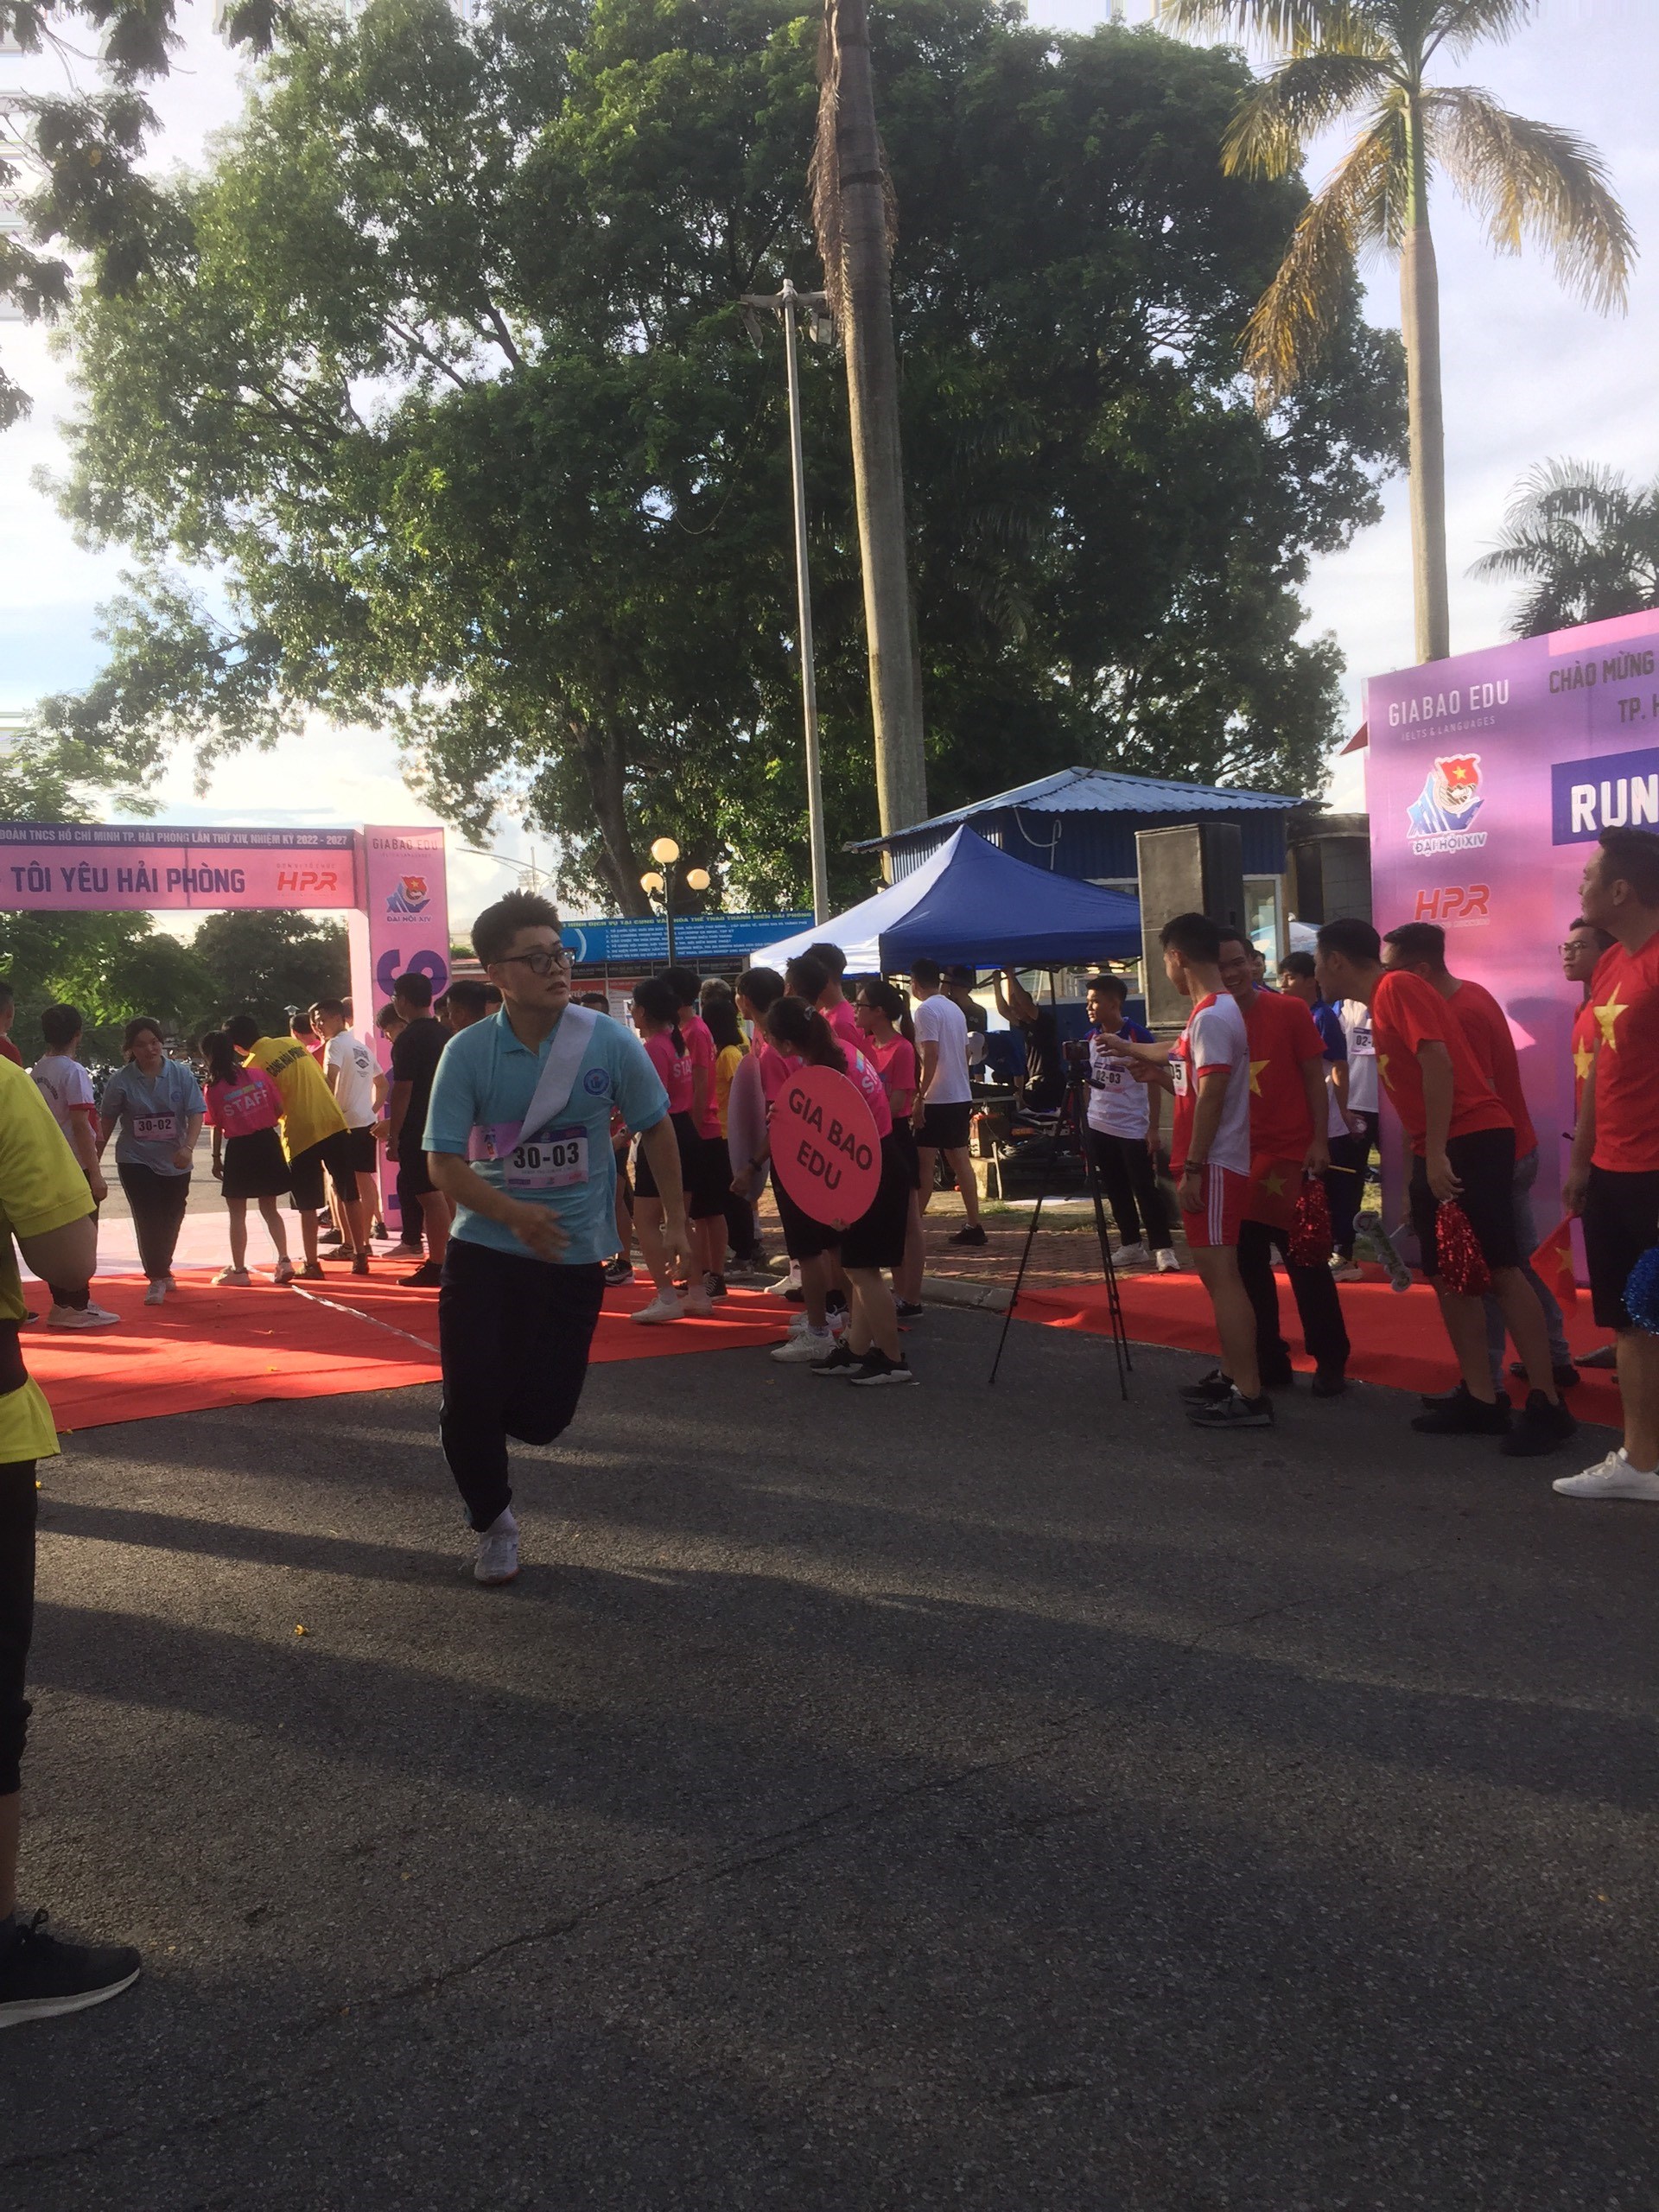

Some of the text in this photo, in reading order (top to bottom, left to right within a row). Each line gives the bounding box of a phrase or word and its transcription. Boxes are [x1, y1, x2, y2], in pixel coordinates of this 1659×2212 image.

[1549, 650, 1655, 693] CHÀO MỪNG
[1389, 679, 1509, 727] GIABAO EDU
[1618, 697, 1645, 722] TP.
[1402, 715, 1496, 741] IELTS & LANGUAGES
[1571, 774, 1659, 833] RUN
[29, 830, 55, 841] TNCS
[58, 828, 71, 841] HỒ
[74, 829, 91, 842] CHÍ
[94, 831, 120, 842] MINH
[123, 831, 136, 842] TP.
[138, 829, 154, 842] HẢI
[156, 830, 189, 843] PHÒNG
[192, 830, 210, 843] LẦN
[213, 832, 231, 843] THỨ
[251, 833, 280, 846] NHIỆM
[296, 835, 318, 845] 2022
[327, 836, 346, 845] 2027
[372, 838, 438, 850] GIABAO EDU
[1465, 833, 1487, 847] XIV
[10, 861, 245, 893] TÔI YÊU HẢI PHÒNG
[277, 872, 337, 891] HPR
[1414, 884, 1490, 921] HPR
[1356, 1035, 1371, 1046] 02-
[673, 1058, 692, 1077] STA
[1096, 1070, 1122, 1084] 02-03
[224, 1090, 268, 1116] STAFF
[138, 1119, 172, 1132] 30-02
[788, 1088, 873, 1171] GIA BAO
[513, 1141, 580, 1169] 30-03
[797, 1140, 842, 1191] EDU
